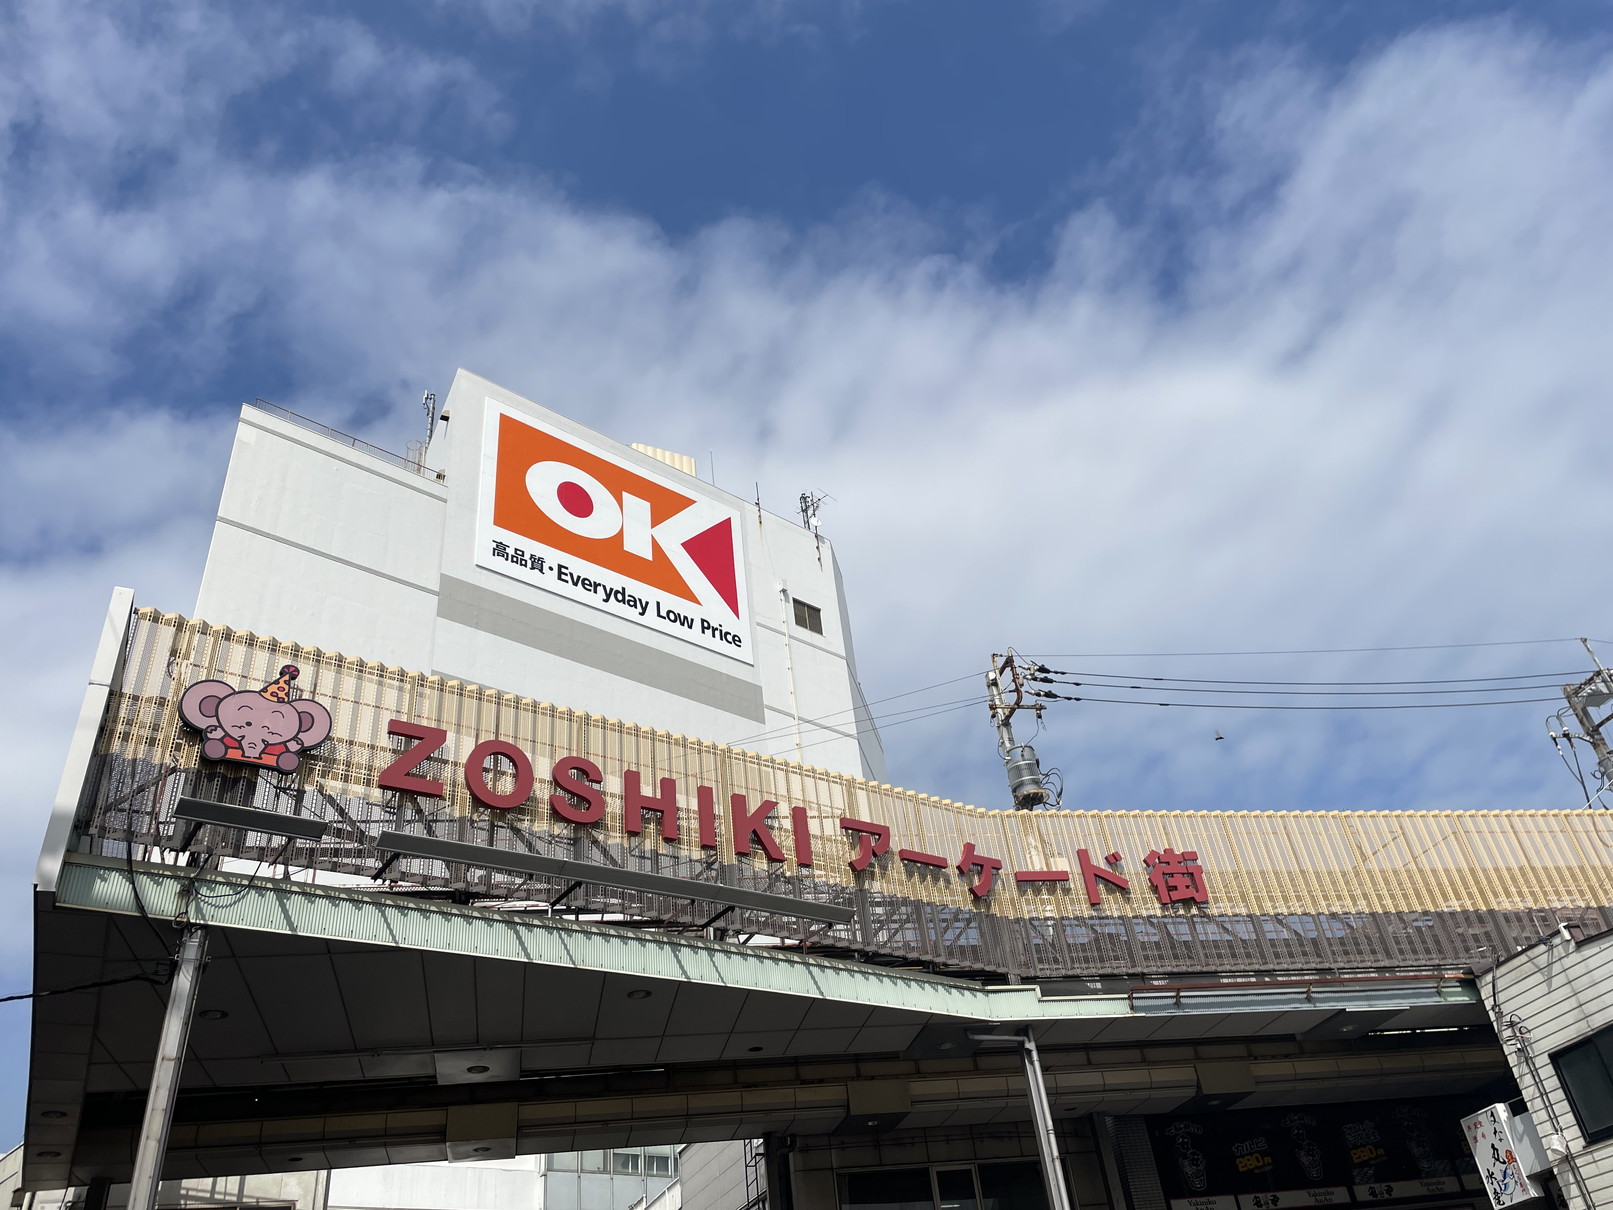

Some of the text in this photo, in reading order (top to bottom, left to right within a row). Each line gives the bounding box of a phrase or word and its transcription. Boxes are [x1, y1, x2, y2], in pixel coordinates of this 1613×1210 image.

[525, 461, 739, 620] OK
[556, 563, 649, 617] Everyday
[655, 600, 695, 630] Low
[700, 617, 742, 648] Price
[378, 718, 1209, 905] ZOSHIKI アーケード街
